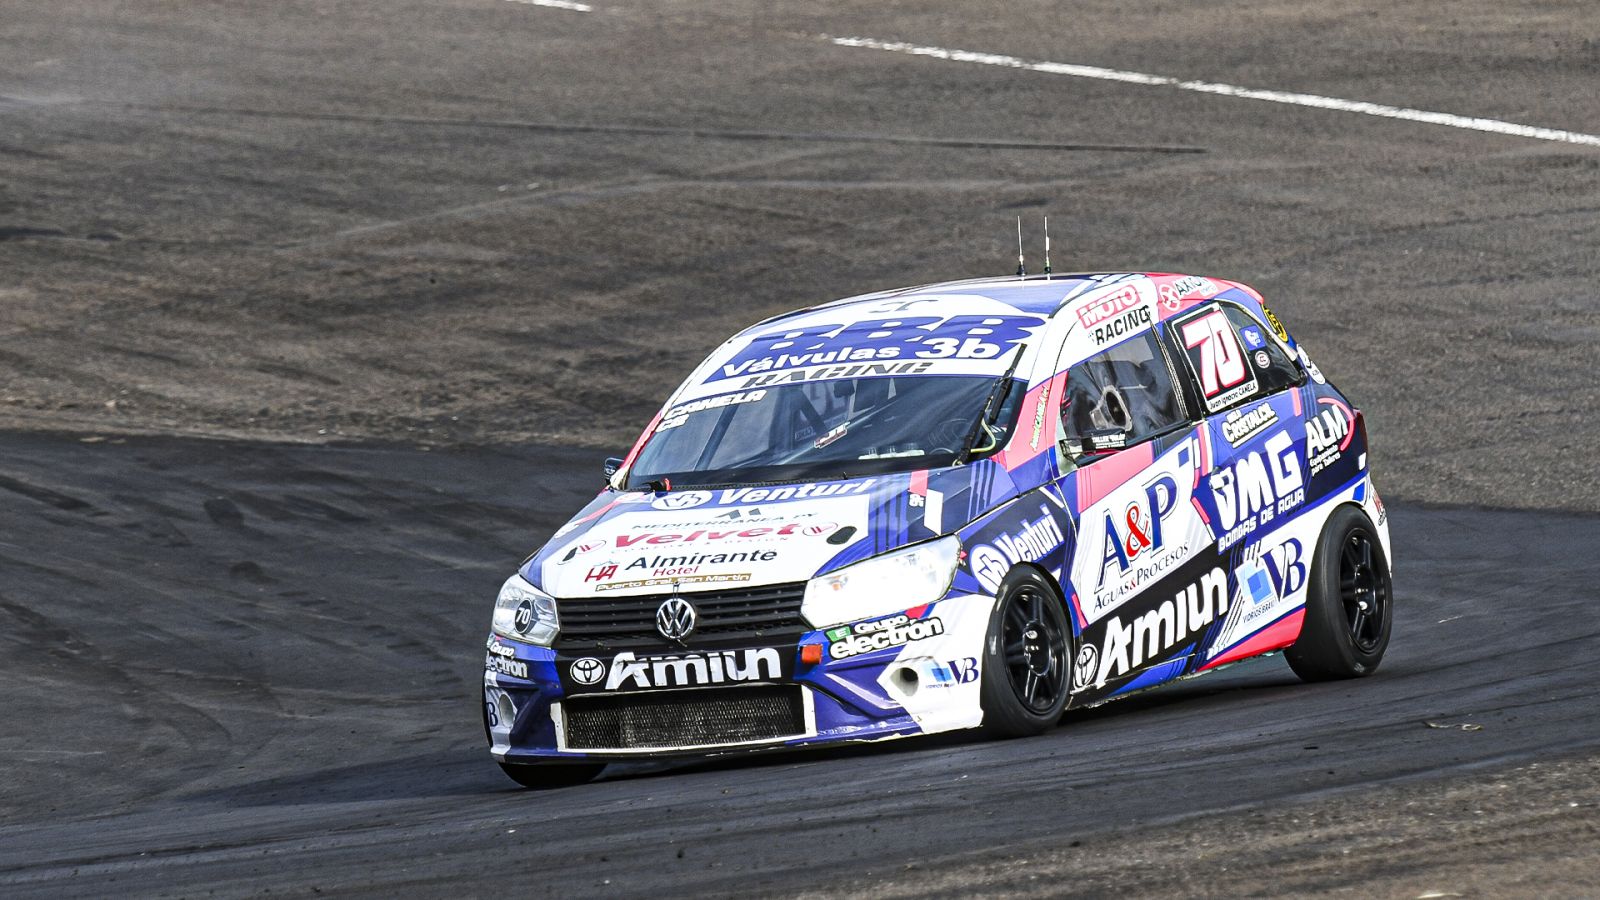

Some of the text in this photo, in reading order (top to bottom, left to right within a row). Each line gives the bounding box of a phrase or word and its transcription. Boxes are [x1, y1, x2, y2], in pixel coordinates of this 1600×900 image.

[1079, 285, 1140, 328] MOTO
[1095, 305, 1151, 345] RACING
[722, 337, 1001, 377] Válvulas 3b
[1181, 310, 1247, 398] 70
[740, 362, 934, 389] RACING
[663, 389, 767, 420] CANELA
[1304, 404, 1349, 459] ALM
[718, 478, 878, 505] Venturi
[615, 522, 801, 548] Velvet
[992, 503, 1065, 563] Venturi
[1094, 471, 1180, 594] A&P
[1218, 488, 1305, 556] BOMBAS DE AGUA
[624, 550, 778, 571] Almirante
[653, 566, 699, 577] Hotel
[1260, 537, 1307, 603] VB
[515, 607, 530, 625] 70
[854, 614, 909, 634] Grupo
[1095, 566, 1229, 690] Amiun
[829, 617, 944, 659] electrón
[485, 650, 528, 678] lectrón
[605, 647, 782, 690] Amiun
[948, 656, 979, 685] VB
